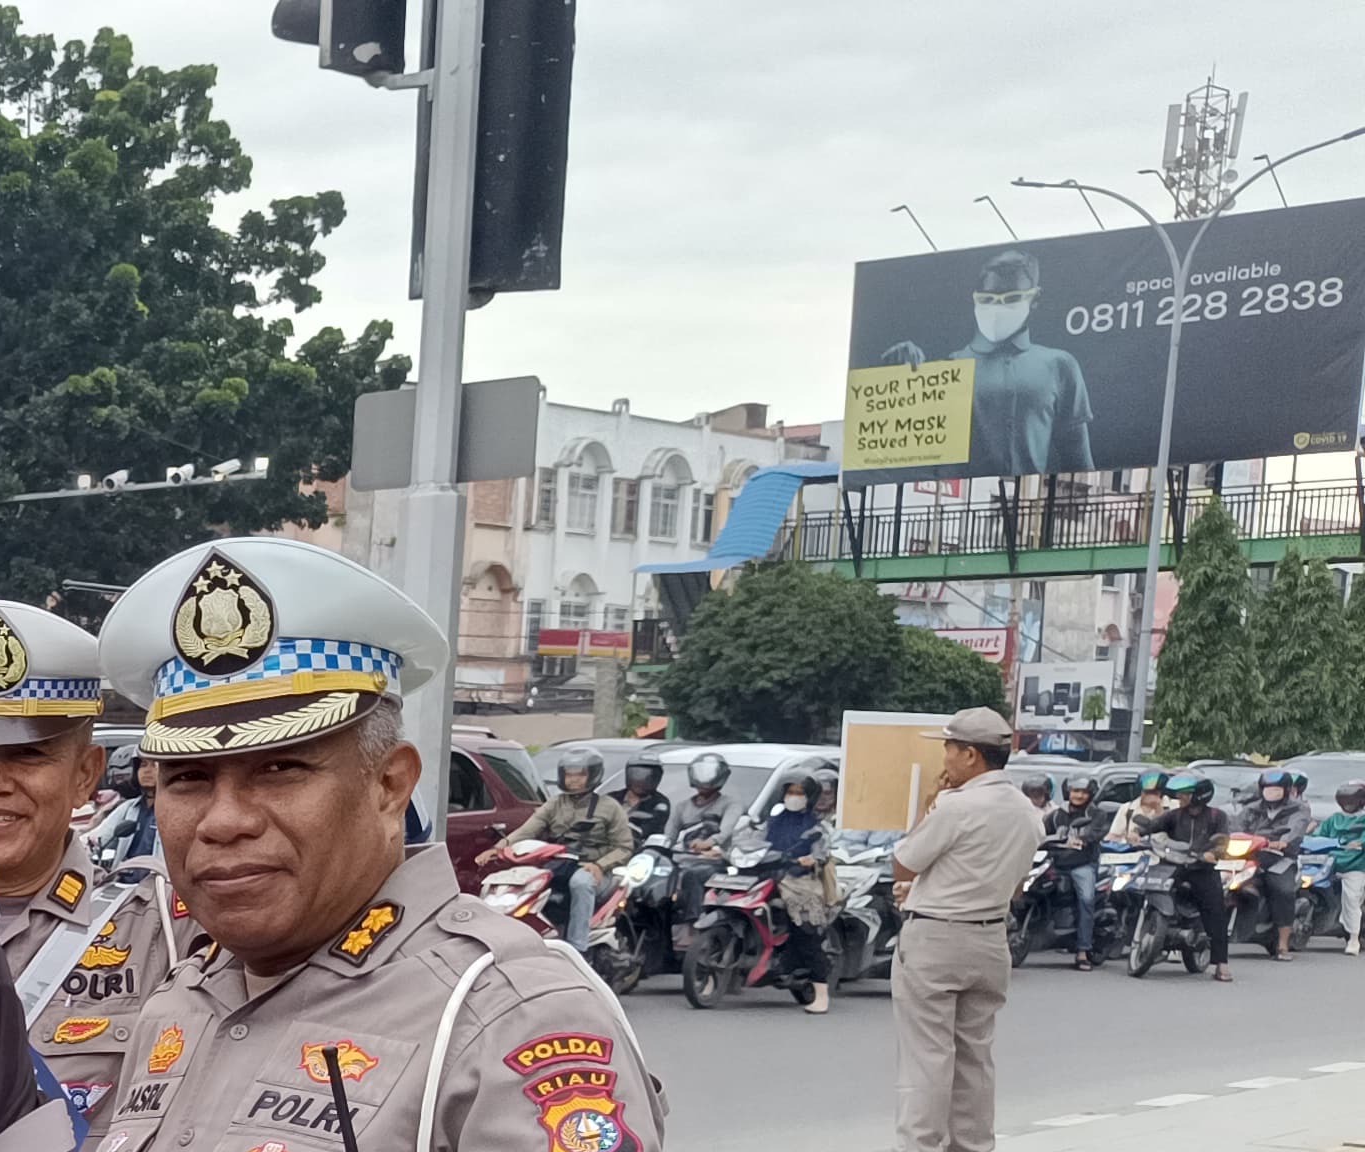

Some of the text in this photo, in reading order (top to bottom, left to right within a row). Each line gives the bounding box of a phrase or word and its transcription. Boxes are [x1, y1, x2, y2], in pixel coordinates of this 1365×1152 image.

[1126, 261, 1282, 295] spac available
[1065, 277, 1344, 335] 0811 228 2838
[62, 968, 135, 1000] OLRI
[517, 1038, 603, 1067] POLDA
[537, 1073, 606, 1095] RIAU
[248, 1090, 360, 1135] POLRI
